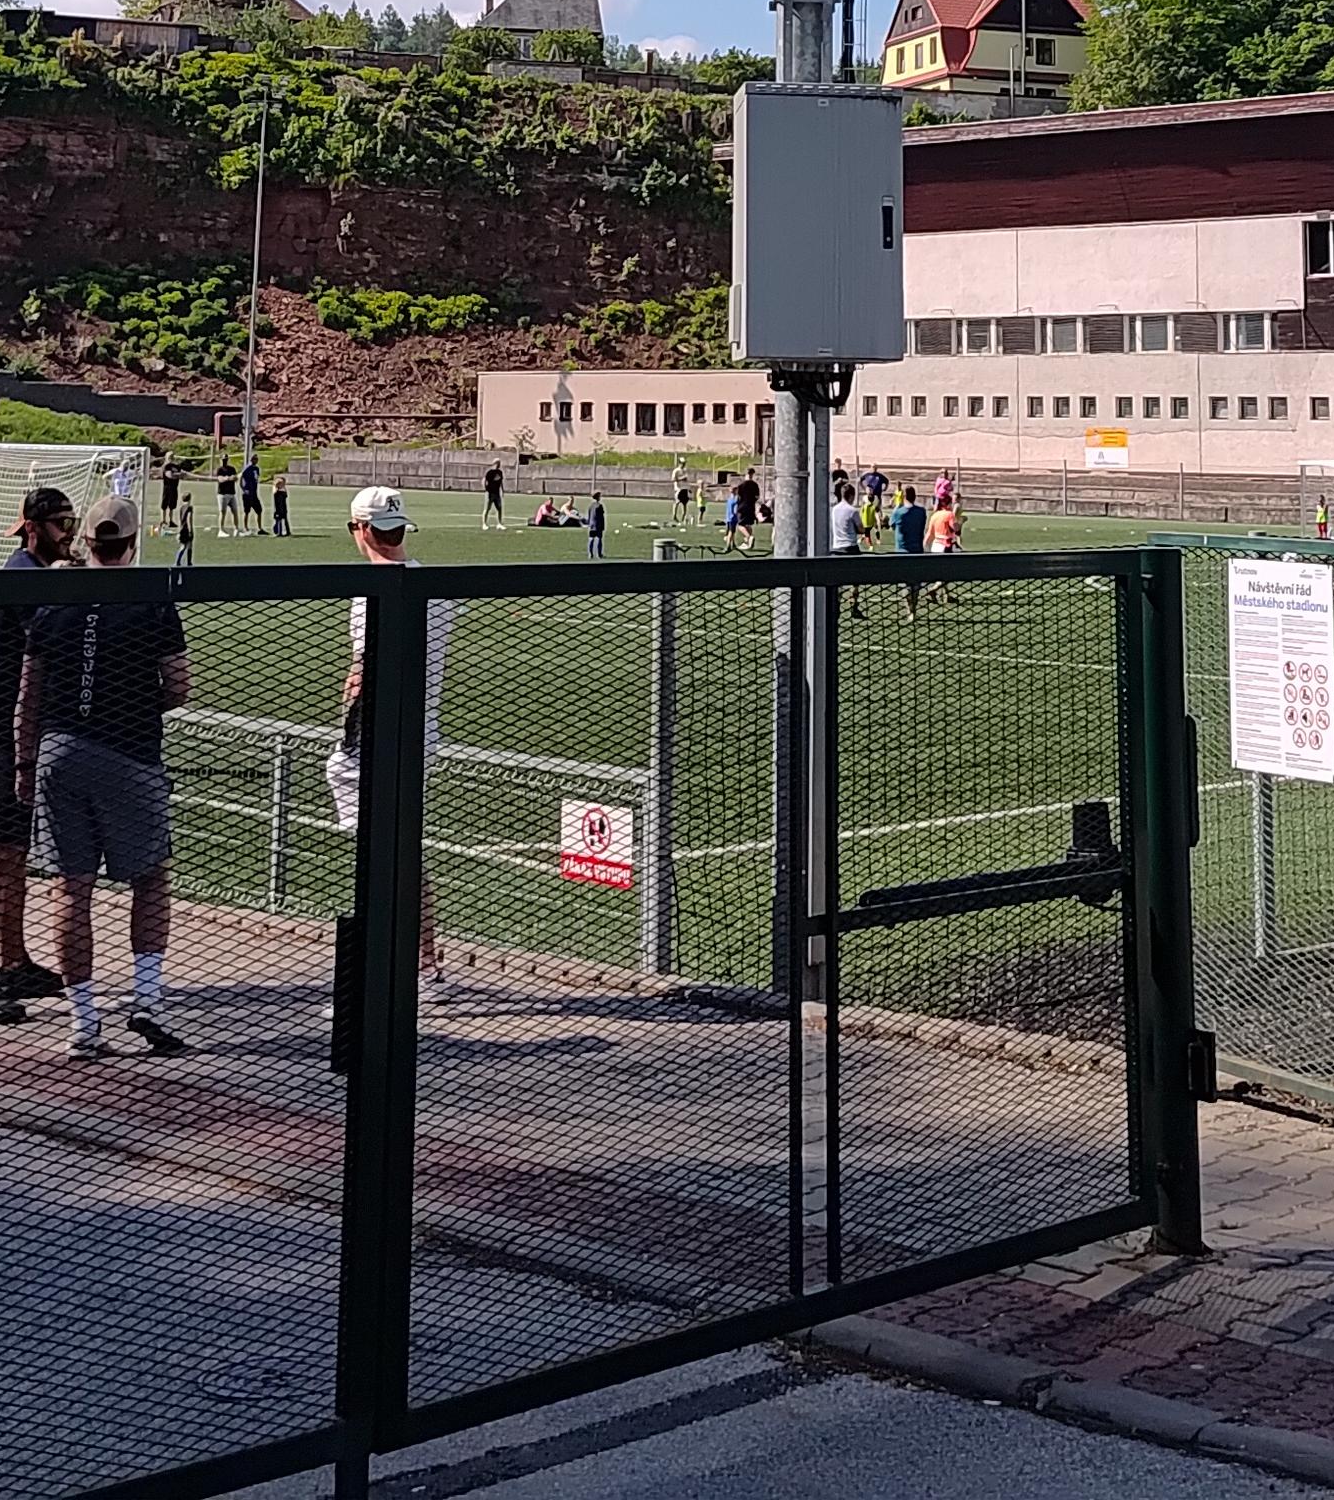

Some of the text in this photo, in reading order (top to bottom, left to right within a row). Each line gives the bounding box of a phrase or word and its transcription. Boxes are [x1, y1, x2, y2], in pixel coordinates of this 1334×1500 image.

[1248, 581, 1311, 596] Návštěvní řád
[1234, 594, 1328, 613] Městského stadionu
